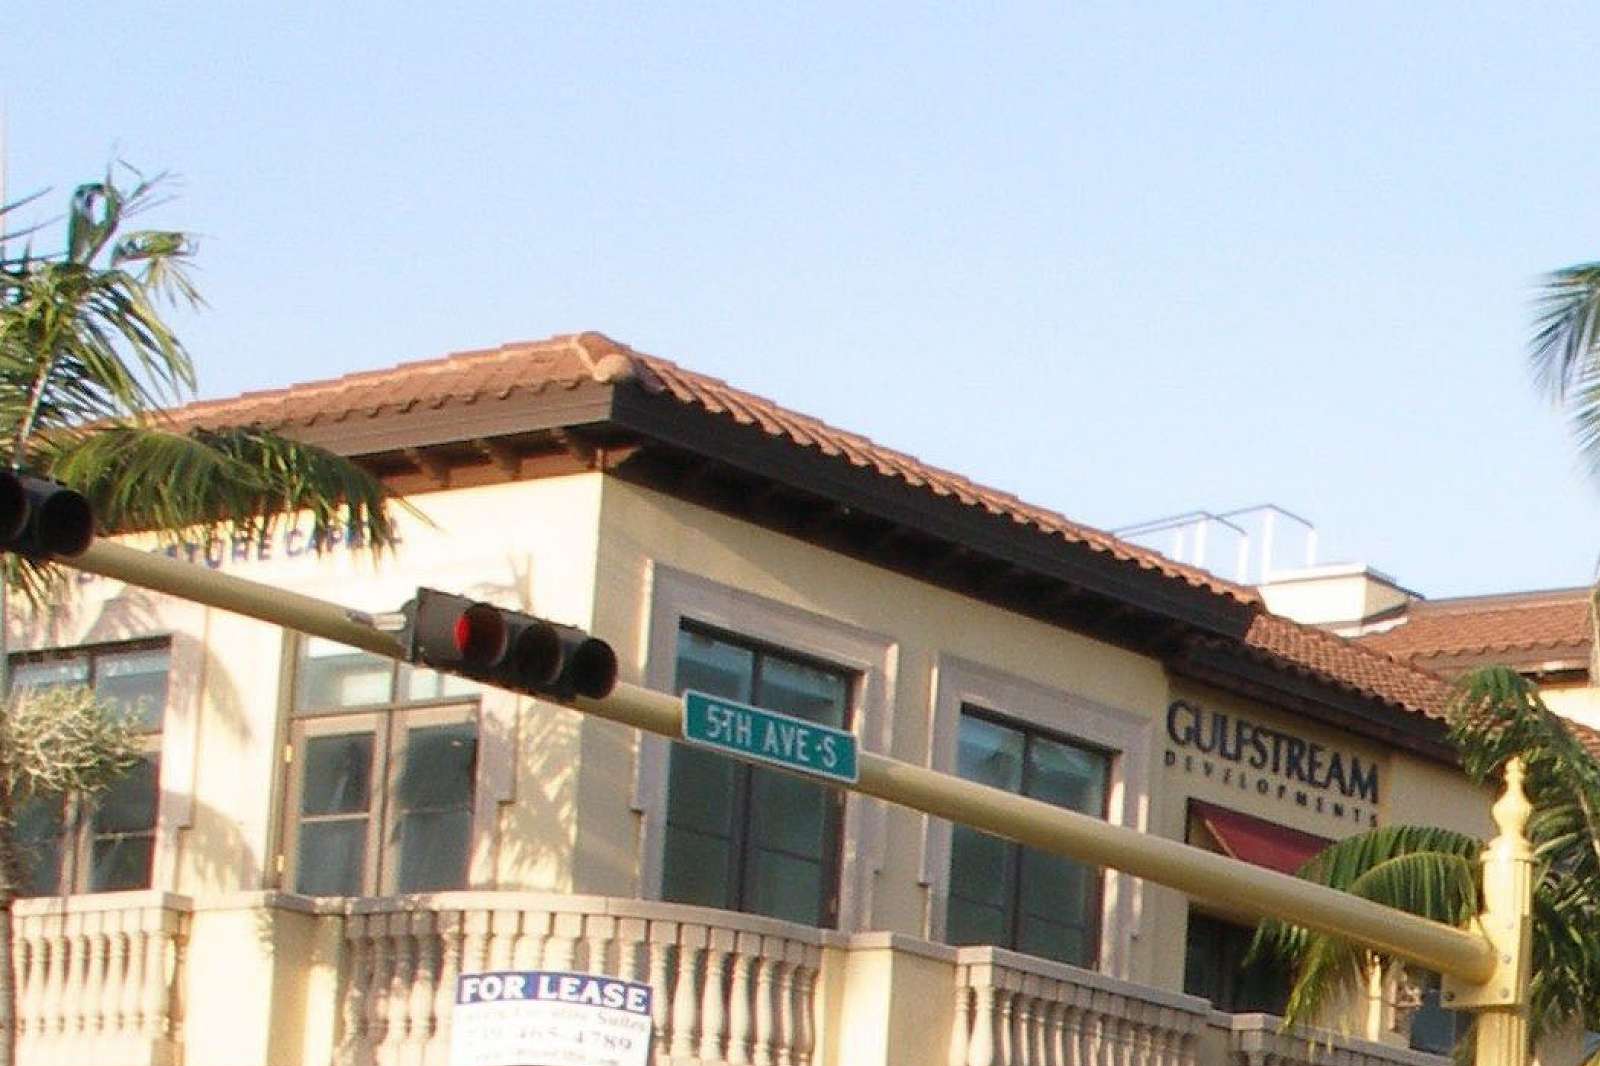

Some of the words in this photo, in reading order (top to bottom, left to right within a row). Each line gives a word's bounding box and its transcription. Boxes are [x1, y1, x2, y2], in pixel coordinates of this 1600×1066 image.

[704, 703, 752, 748] 5TH
[763, 719, 811, 763] AVE
[821, 734, 838, 769] S
[1166, 699, 1379, 804] GULFSTREAM
[1163, 749, 1379, 828] DEVELOPMENTS
[461, 974, 527, 1003] FOR
[538, 974, 648, 1012] LEASE
